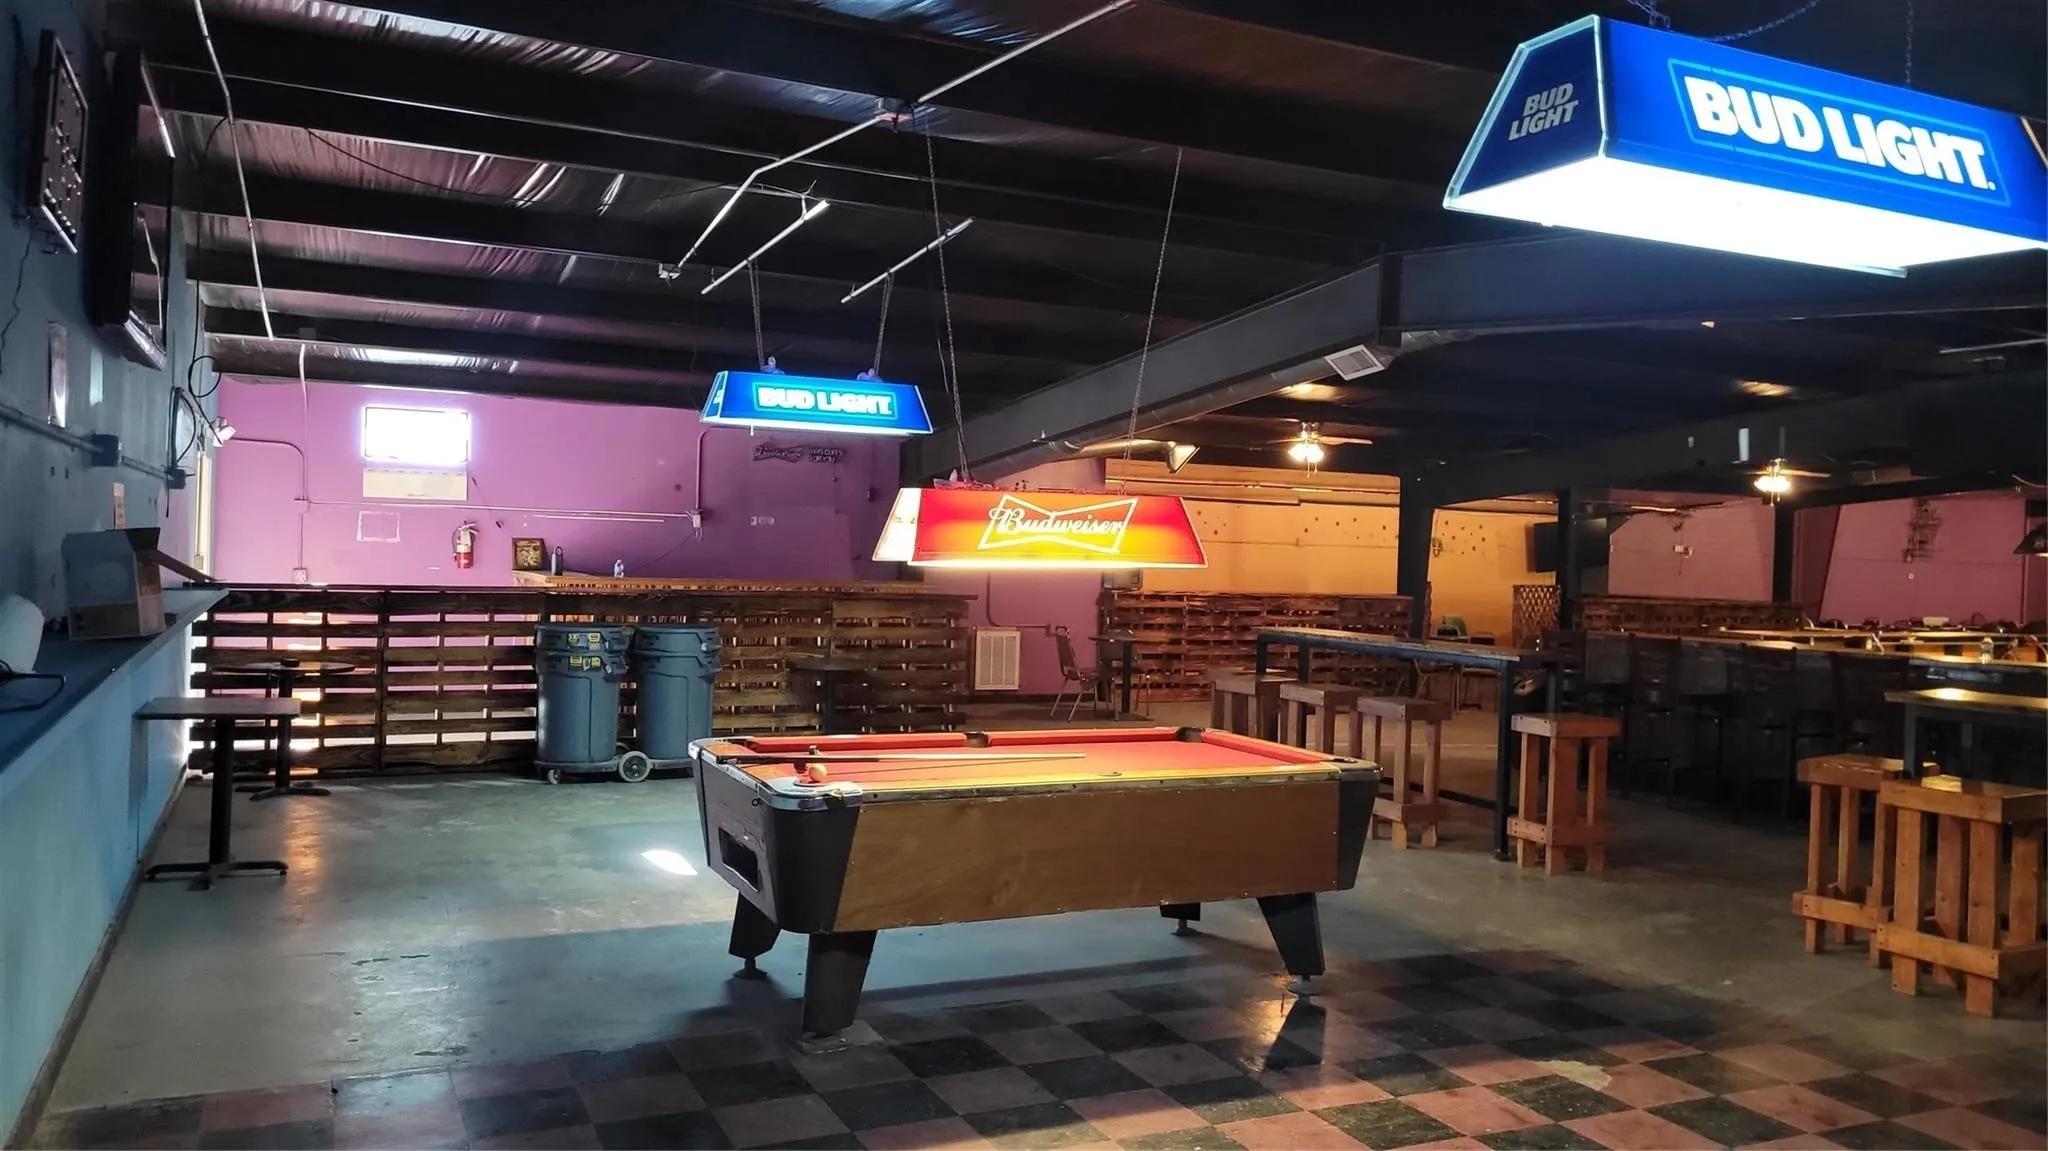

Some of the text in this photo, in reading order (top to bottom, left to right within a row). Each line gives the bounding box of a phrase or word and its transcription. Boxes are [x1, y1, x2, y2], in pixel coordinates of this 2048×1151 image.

[1523, 83, 1574, 117] BUD
[1684, 76, 1824, 152] BUD
[1508, 100, 1579, 141] LIGHT
[758, 387, 816, 410] BUD
[988, 507, 1126, 535] Budweiser
